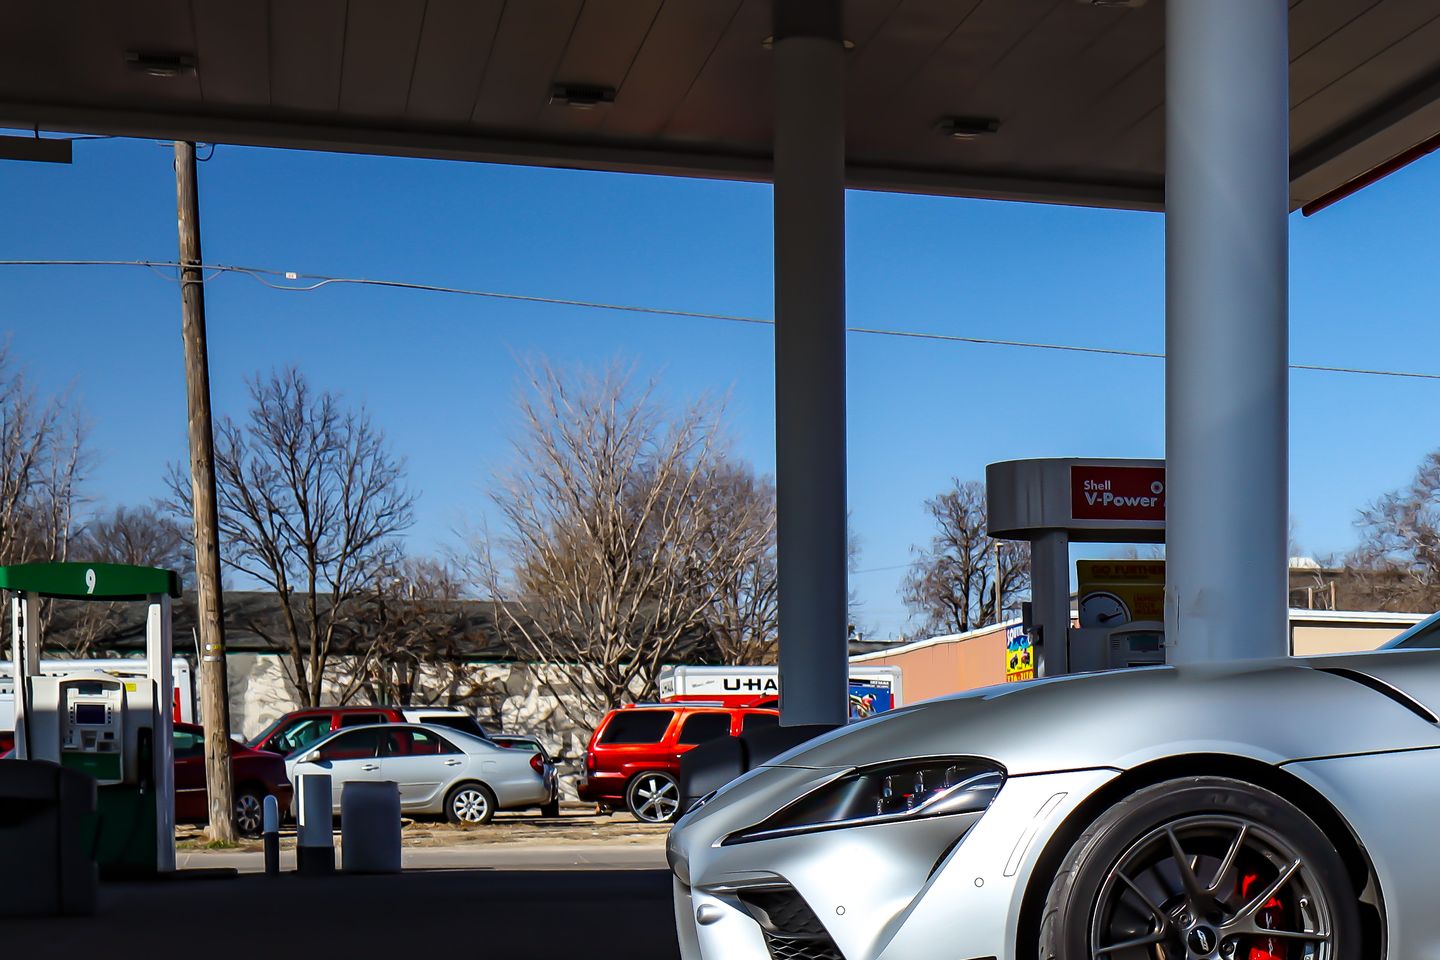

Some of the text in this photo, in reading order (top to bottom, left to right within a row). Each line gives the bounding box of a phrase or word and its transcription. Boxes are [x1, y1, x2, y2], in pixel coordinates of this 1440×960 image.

[1084, 480, 1111, 490] Shell
[1084, 491, 1158, 507] V-Power
[85, 568, 96, 595] 9
